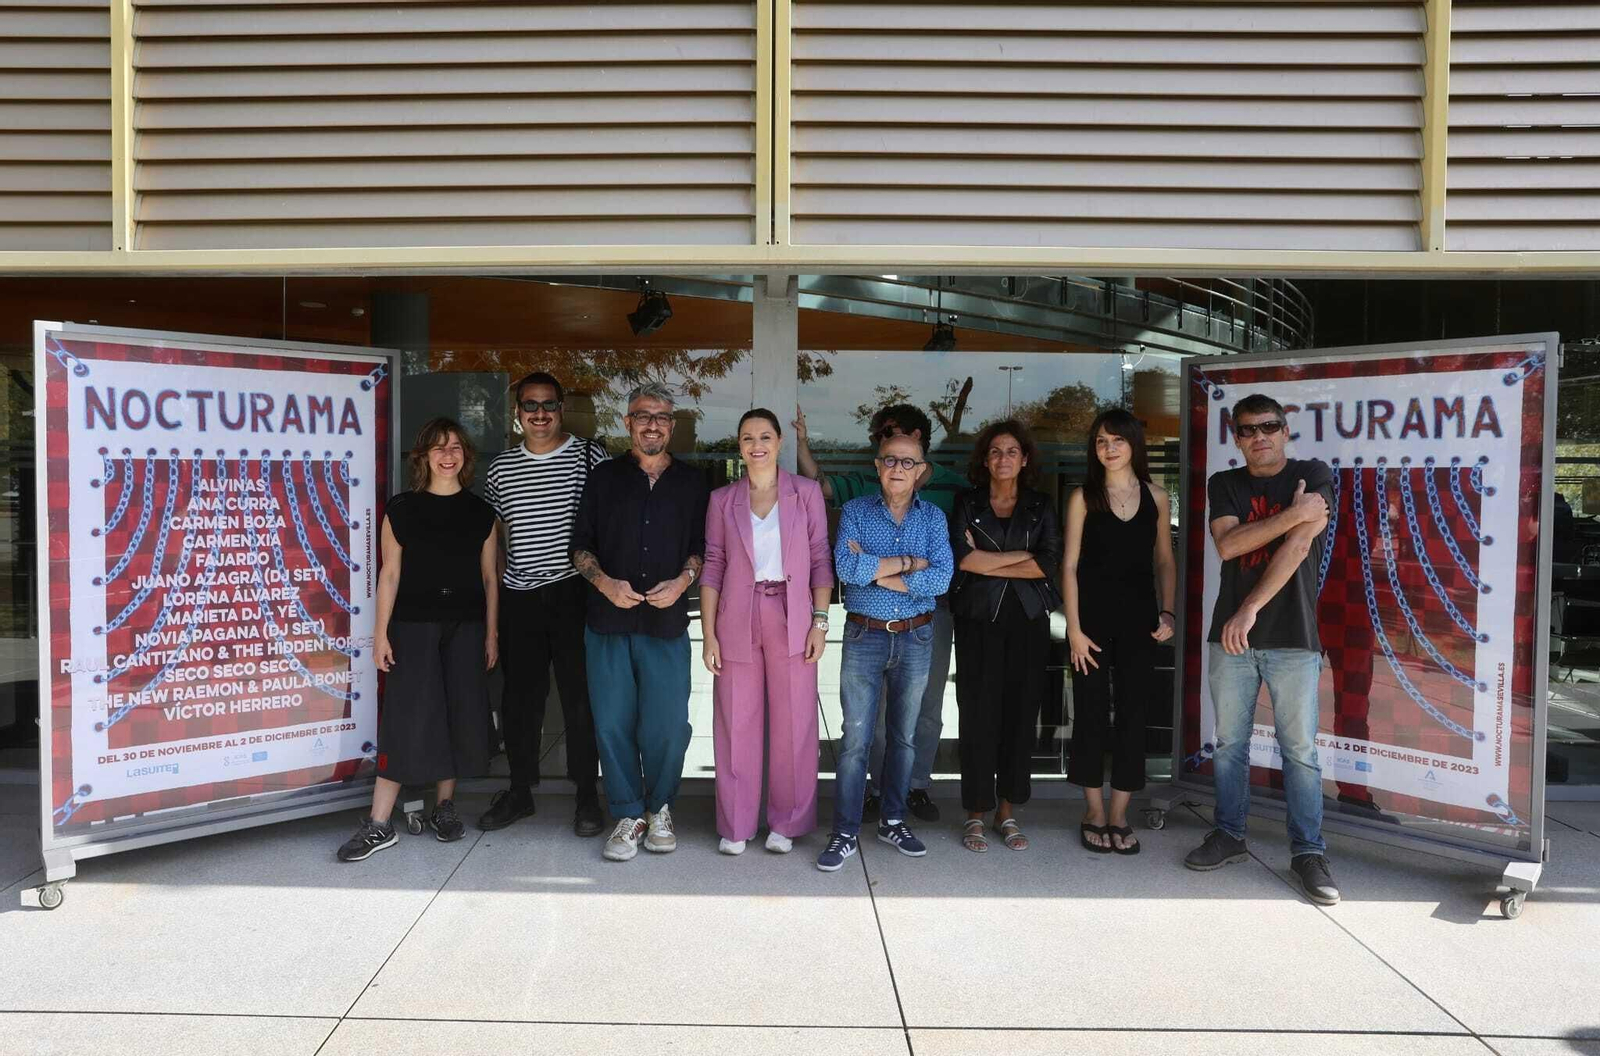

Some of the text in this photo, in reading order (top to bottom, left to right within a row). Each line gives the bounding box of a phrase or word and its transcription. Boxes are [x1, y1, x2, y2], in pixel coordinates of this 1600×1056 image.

[84, 385, 363, 436] NOCTURAMA
[199, 478, 266, 492] ALVINAS
[187, 497, 280, 511] ANA CURRA
[170, 515, 286, 530] CARMEN BOZA
[183, 534, 281, 549] CARMEN XIA
[195, 552, 270, 567] FAJARDO
[131, 564, 326, 590] JUANO AZAGRA (DJ SET)
[163, 584, 299, 607] LORENA ÁLVAREZ
[167, 608, 238, 625] MARIETA
[242, 608, 261, 620] DJ
[277, 601, 298, 618] YÉ
[135, 618, 326, 647] NOVIA PAGANA (DJ SET)
[114, 649, 214, 668] CANTIZANO
[217, 646, 230, 659] &
[233, 643, 263, 658] THE
[267, 639, 323, 656] HIDDEN
[328, 636, 375, 651] FORCE
[165, 658, 300, 683] SECO SECO SECO
[88, 671, 363, 711] THE NEW RAEMON & PAULA BONET
[164, 694, 302, 721] VÍCTOR HERRERO
[1495, 662, 1505, 766] WWW.NOCTURAMASEVILLA.ES
[97, 722, 356, 765] DEL 30 DE NOVIEMBRE AL 2 DE DICIEMBRE DE 2023
[1328, 741, 1342, 750] AL
[1353, 744, 1367, 753] DE
[1370, 747, 1429, 766] DICIEMBRE
[1432, 759, 1448, 769] DE
[1451, 762, 1479, 775] 2023
